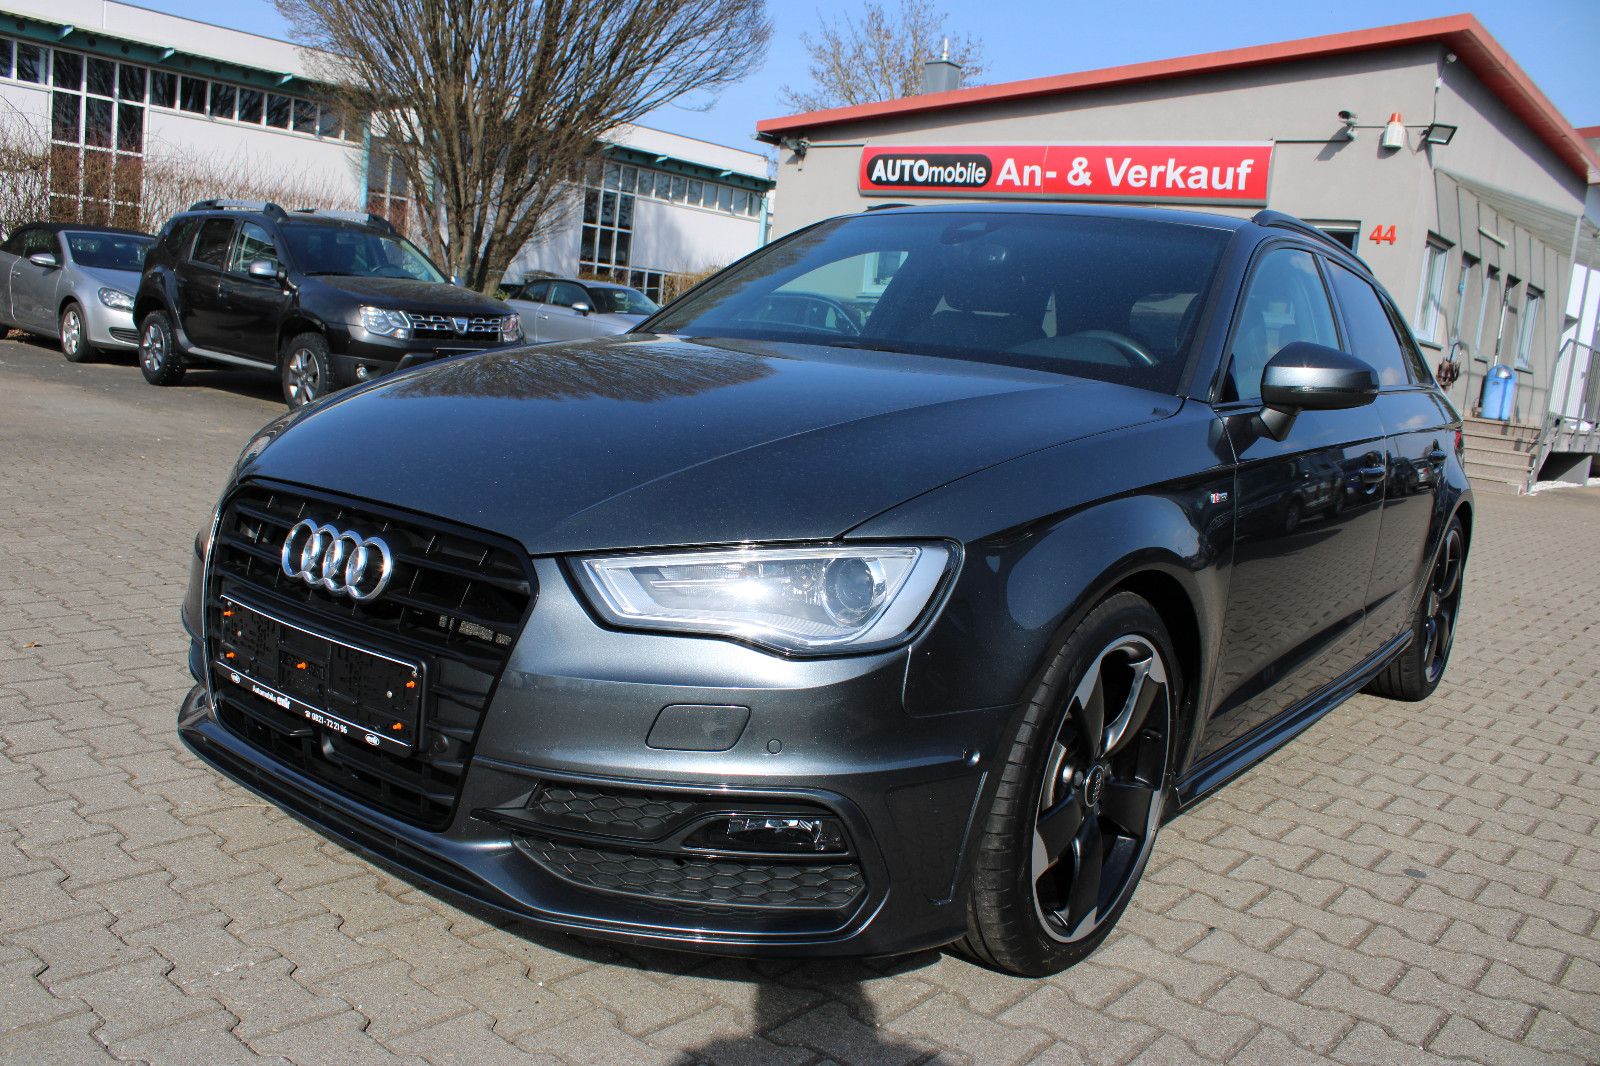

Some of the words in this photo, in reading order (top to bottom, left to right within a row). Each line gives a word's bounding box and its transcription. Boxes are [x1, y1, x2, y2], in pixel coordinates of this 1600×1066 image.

[871, 158, 987, 184] AUTOmobile
[996, 158, 1057, 187] An-
[1067, 157, 1092, 187] &
[1105, 157, 1253, 190] Verkauf
[1369, 224, 1396, 245] 44
